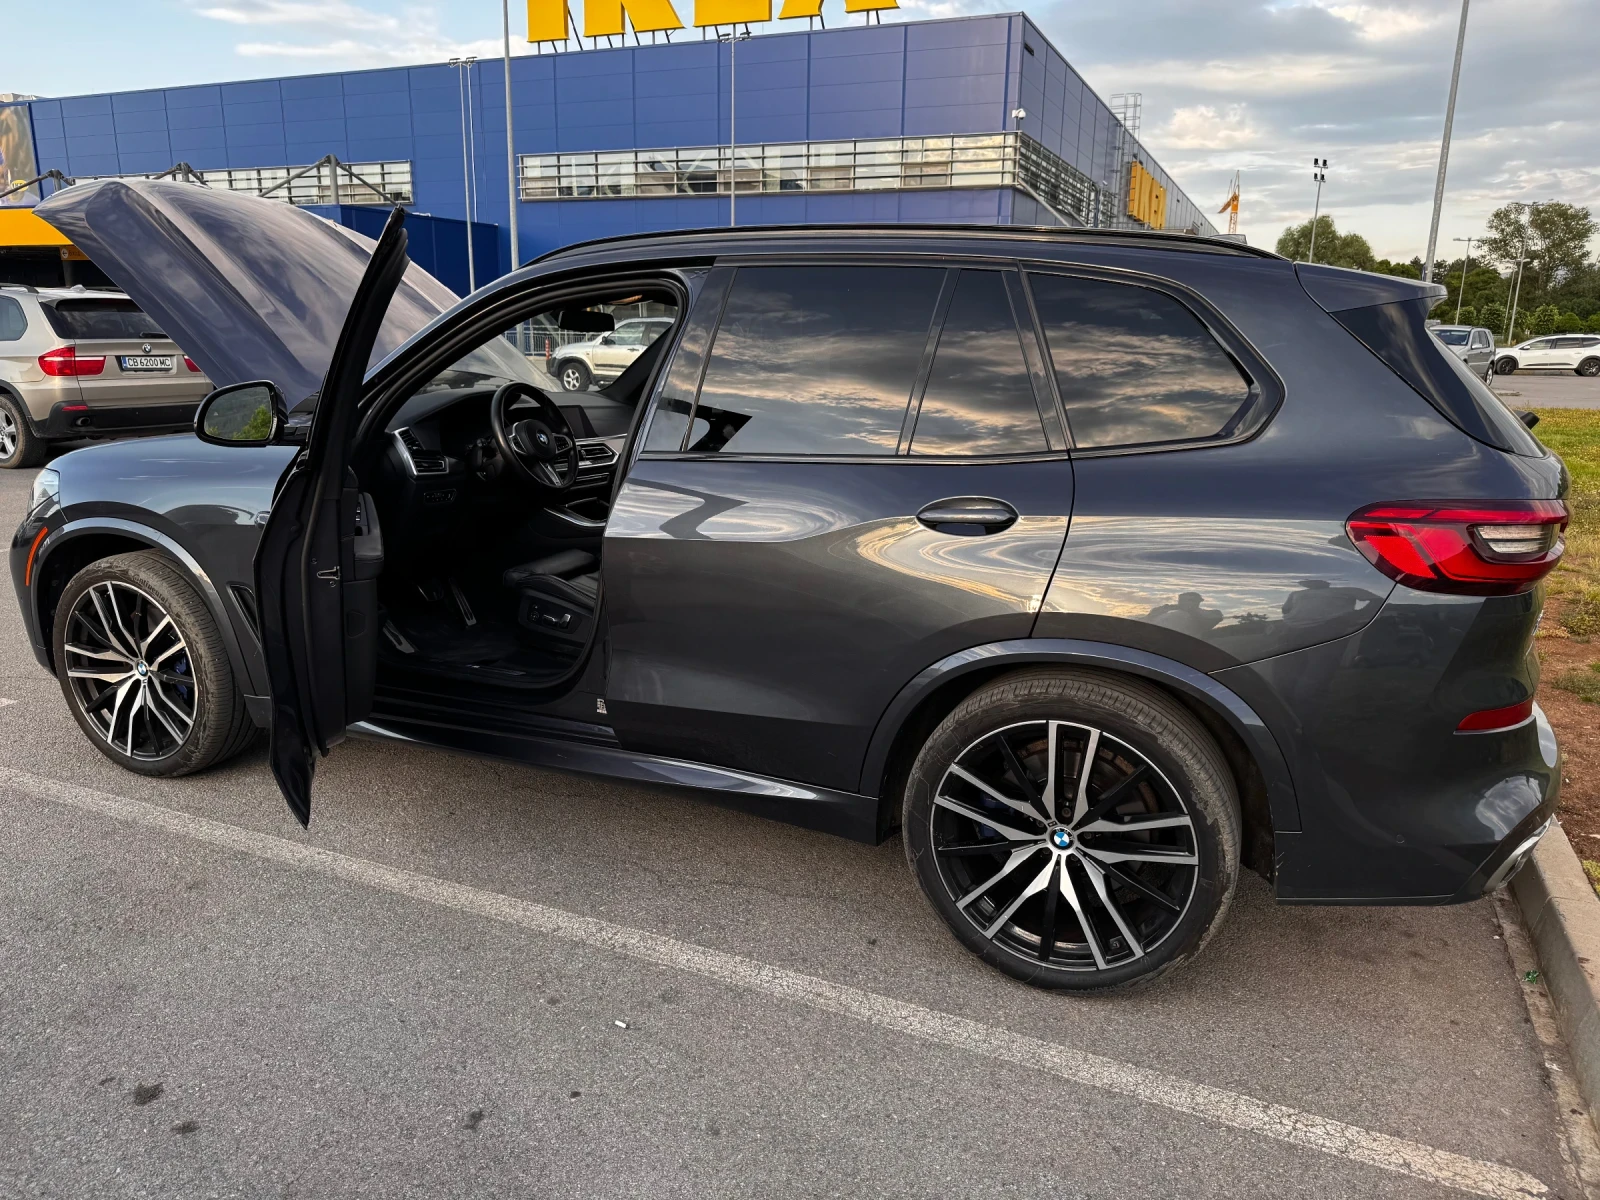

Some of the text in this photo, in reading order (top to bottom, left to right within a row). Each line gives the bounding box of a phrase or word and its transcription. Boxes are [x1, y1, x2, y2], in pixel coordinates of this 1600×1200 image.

[128, 357, 171, 367] CB 6200 MC
